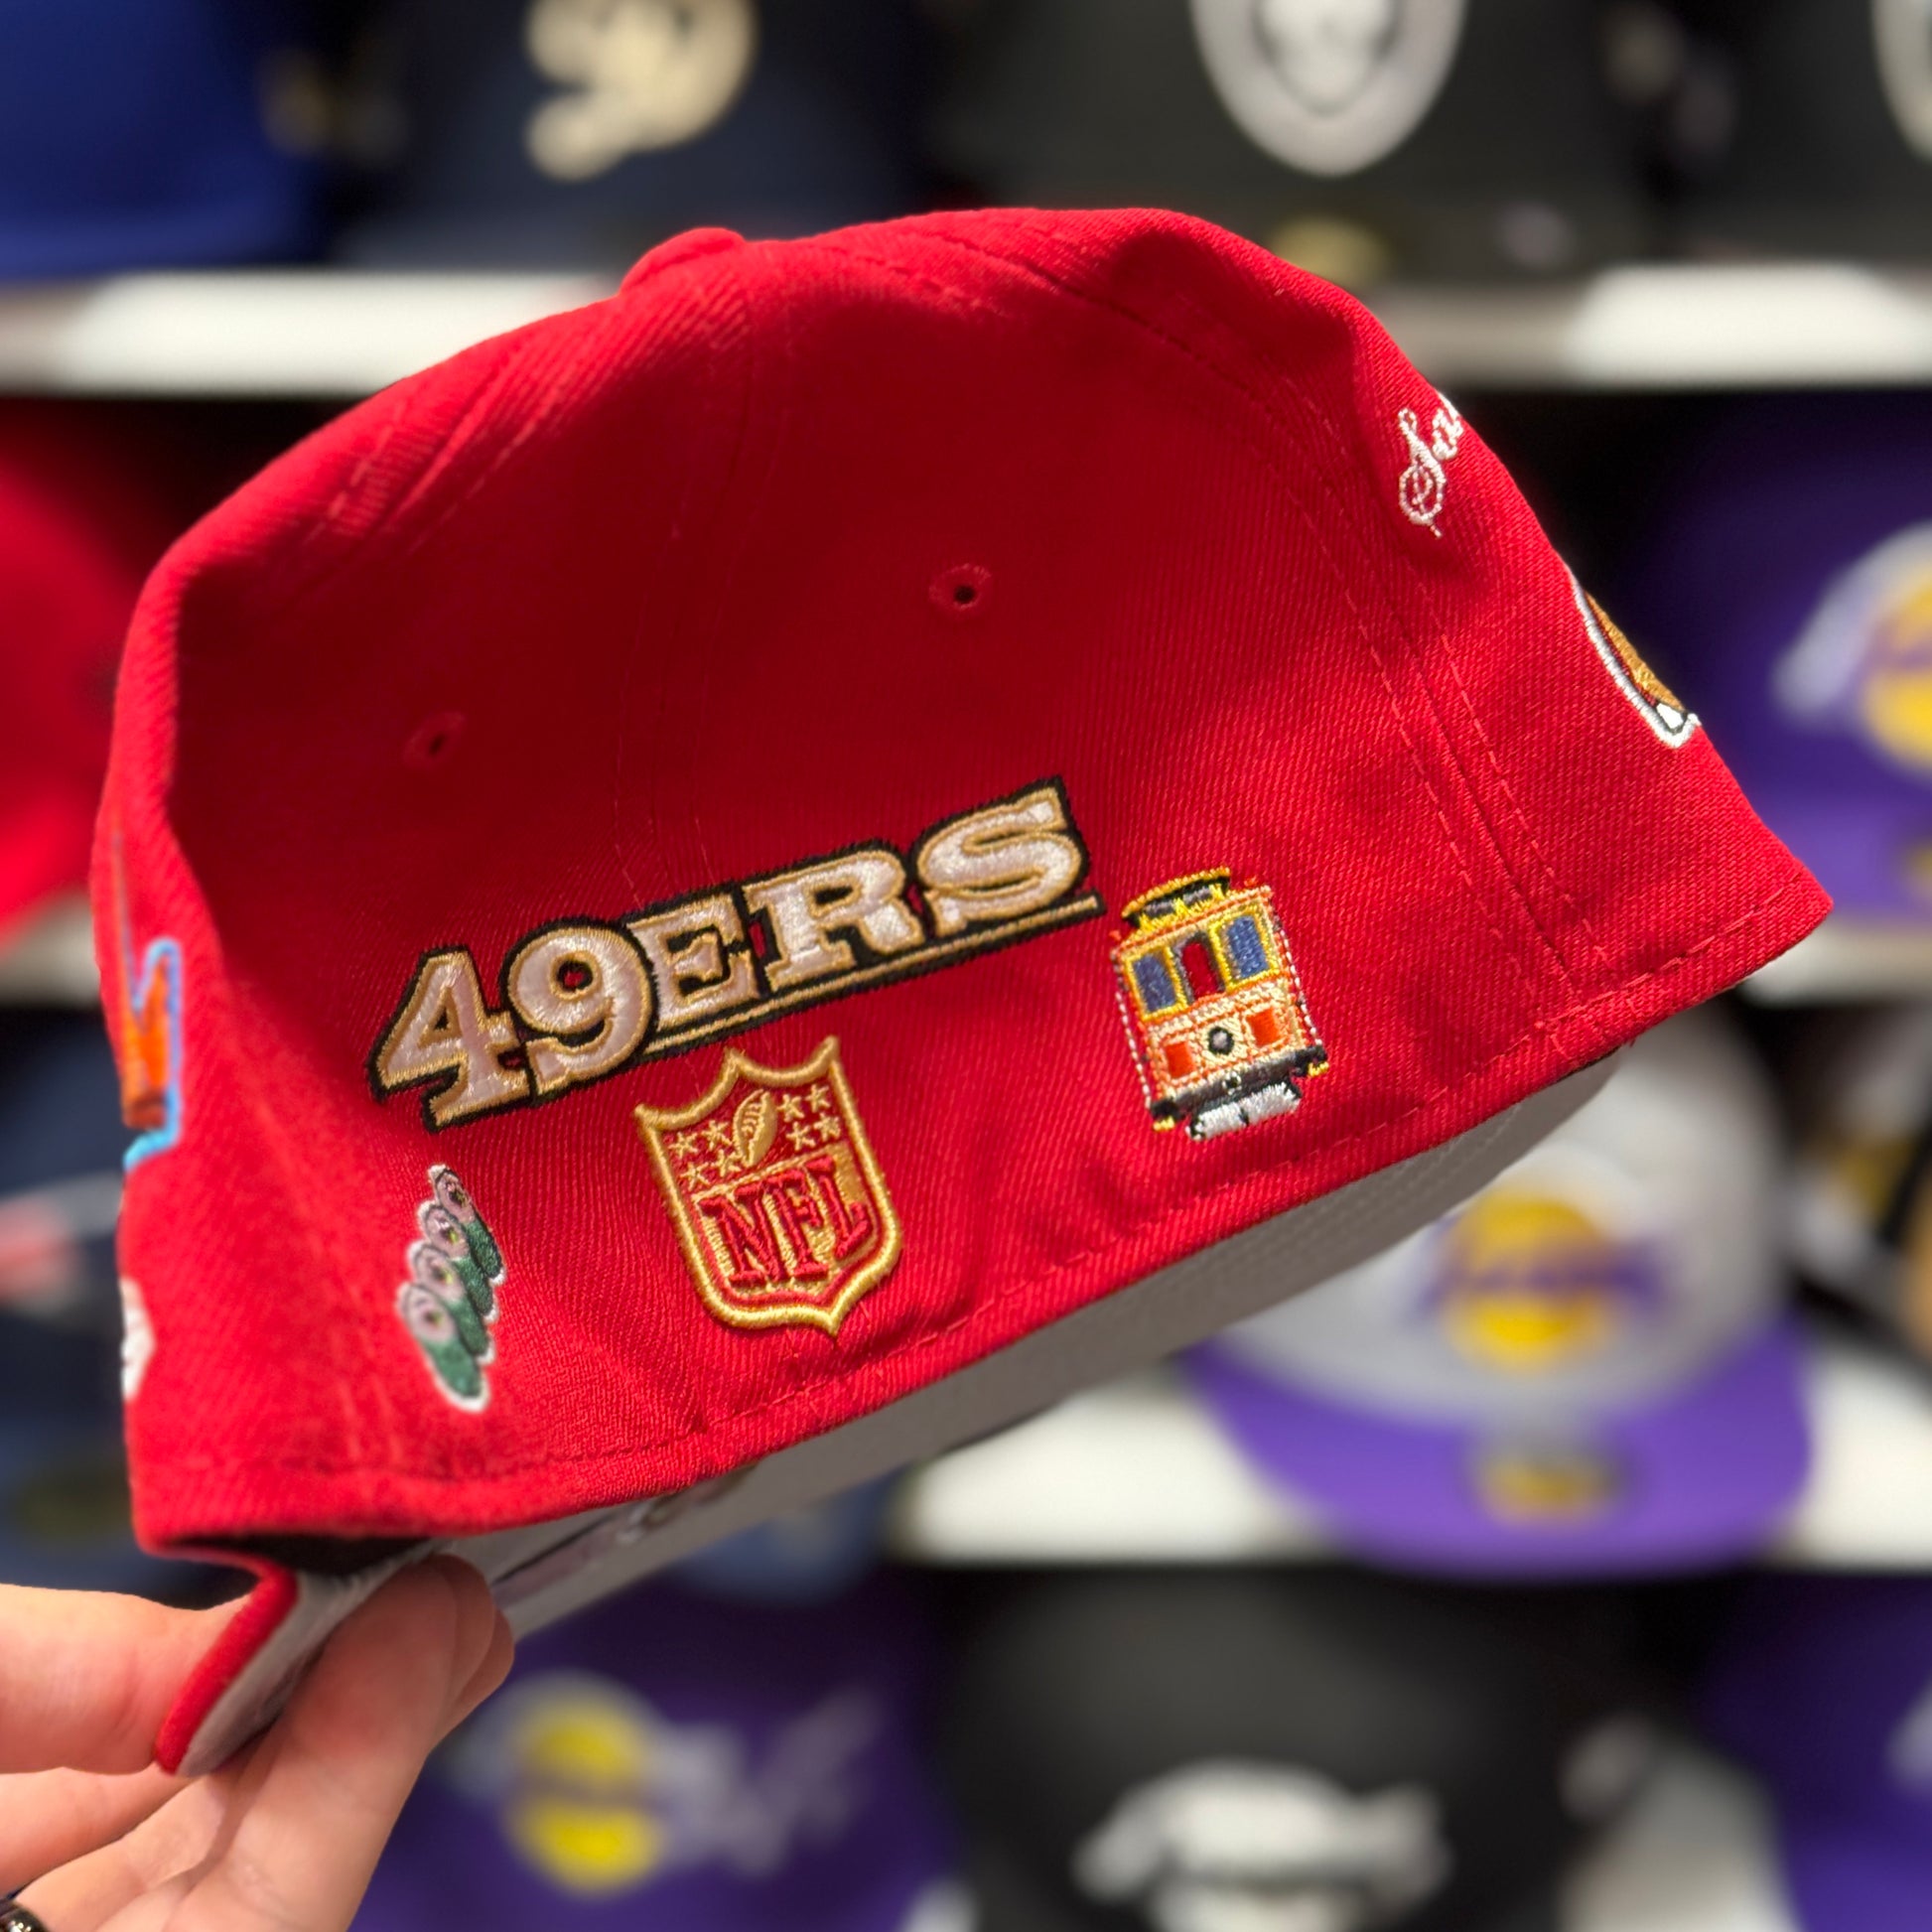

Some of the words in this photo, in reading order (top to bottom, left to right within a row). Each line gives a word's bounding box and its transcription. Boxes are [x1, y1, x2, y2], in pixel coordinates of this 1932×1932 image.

[1398, 392, 1463, 538] Sa
[369, 777, 1096, 1130] 49ERS
[698, 1155, 874, 1287] NFL
